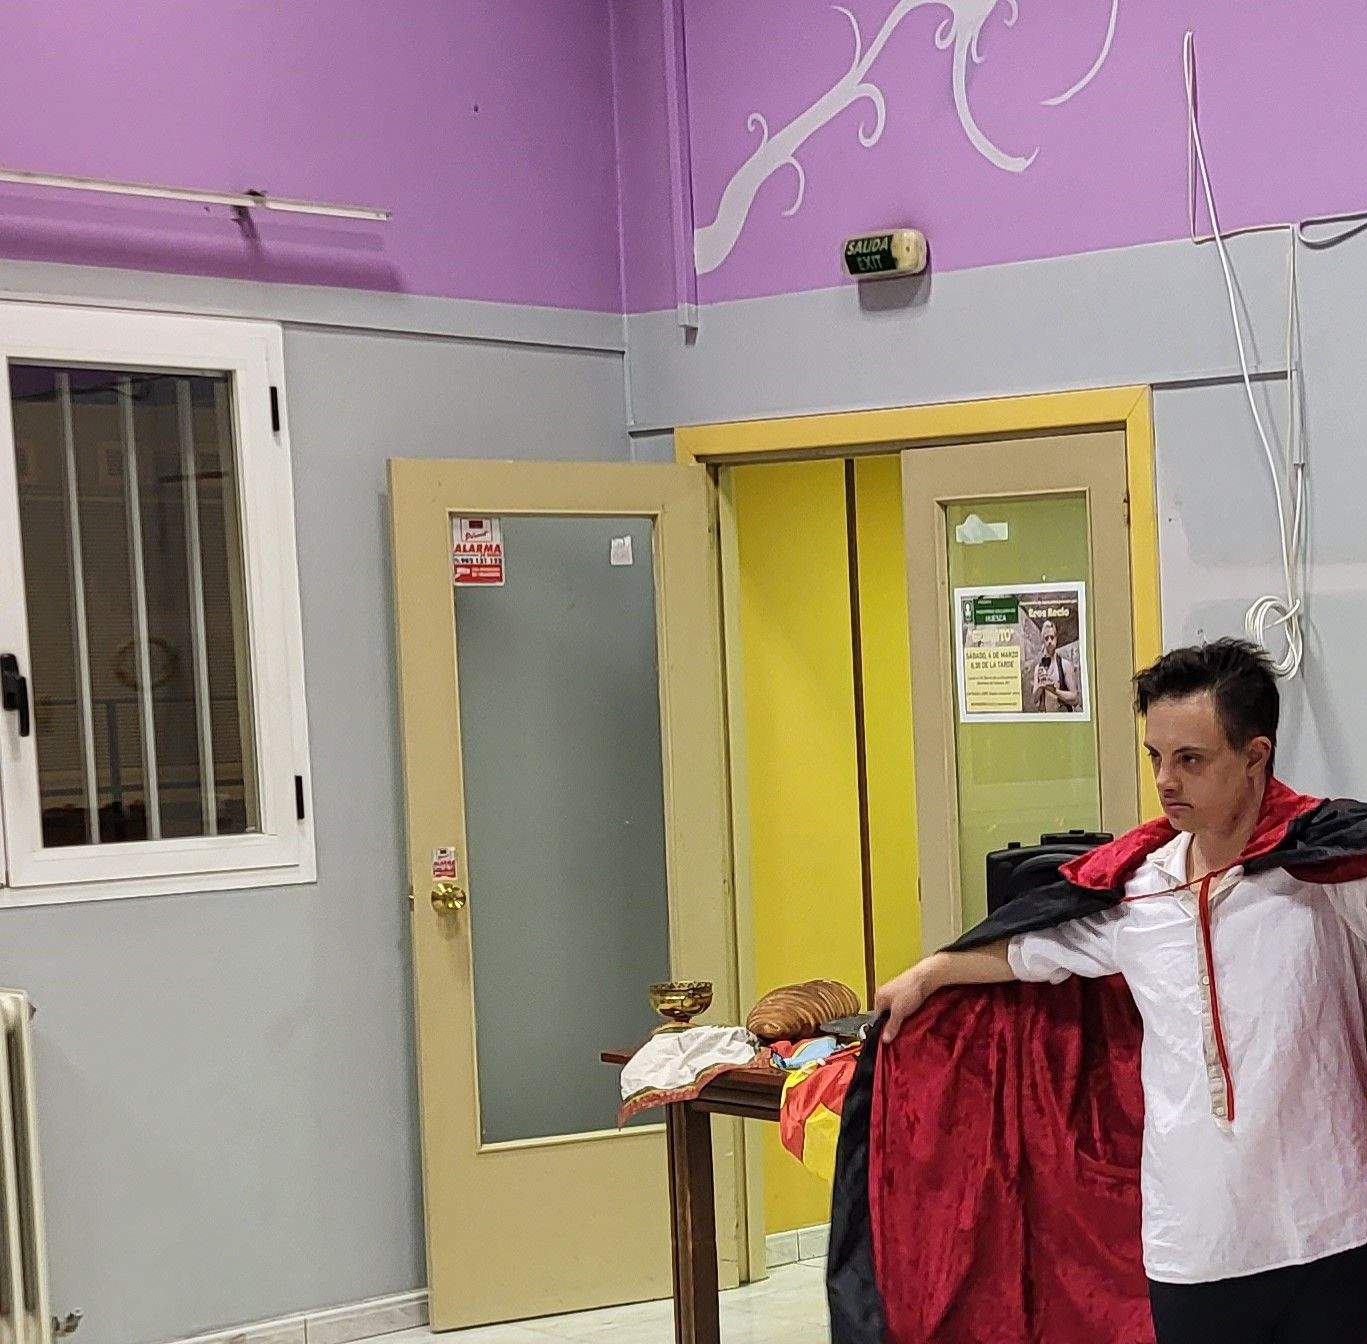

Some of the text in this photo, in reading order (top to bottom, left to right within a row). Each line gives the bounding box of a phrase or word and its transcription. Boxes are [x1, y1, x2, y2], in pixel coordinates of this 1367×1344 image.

[847, 236, 889, 256] SALIDA
[857, 254, 883, 271] EXIT
[455, 543, 501, 553] ALARMA
